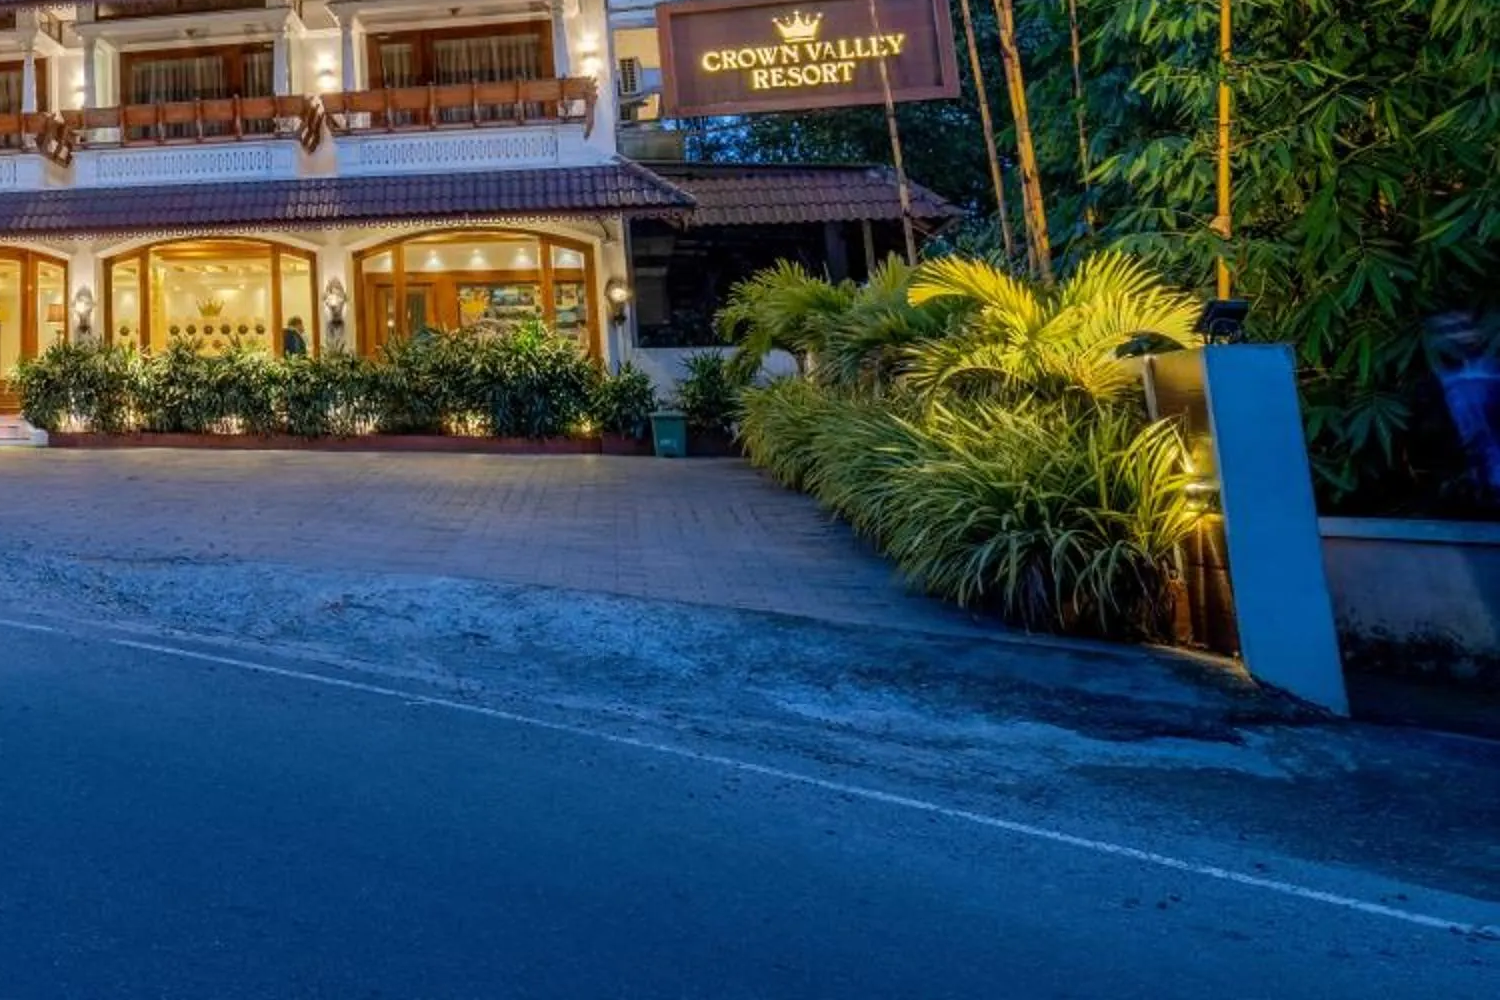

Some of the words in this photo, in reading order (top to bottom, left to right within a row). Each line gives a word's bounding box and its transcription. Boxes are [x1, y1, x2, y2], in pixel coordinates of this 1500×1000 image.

[703, 45, 799, 72] CROWN
[806, 34, 905, 61] VALLEY
[752, 61, 855, 89] RESORT
